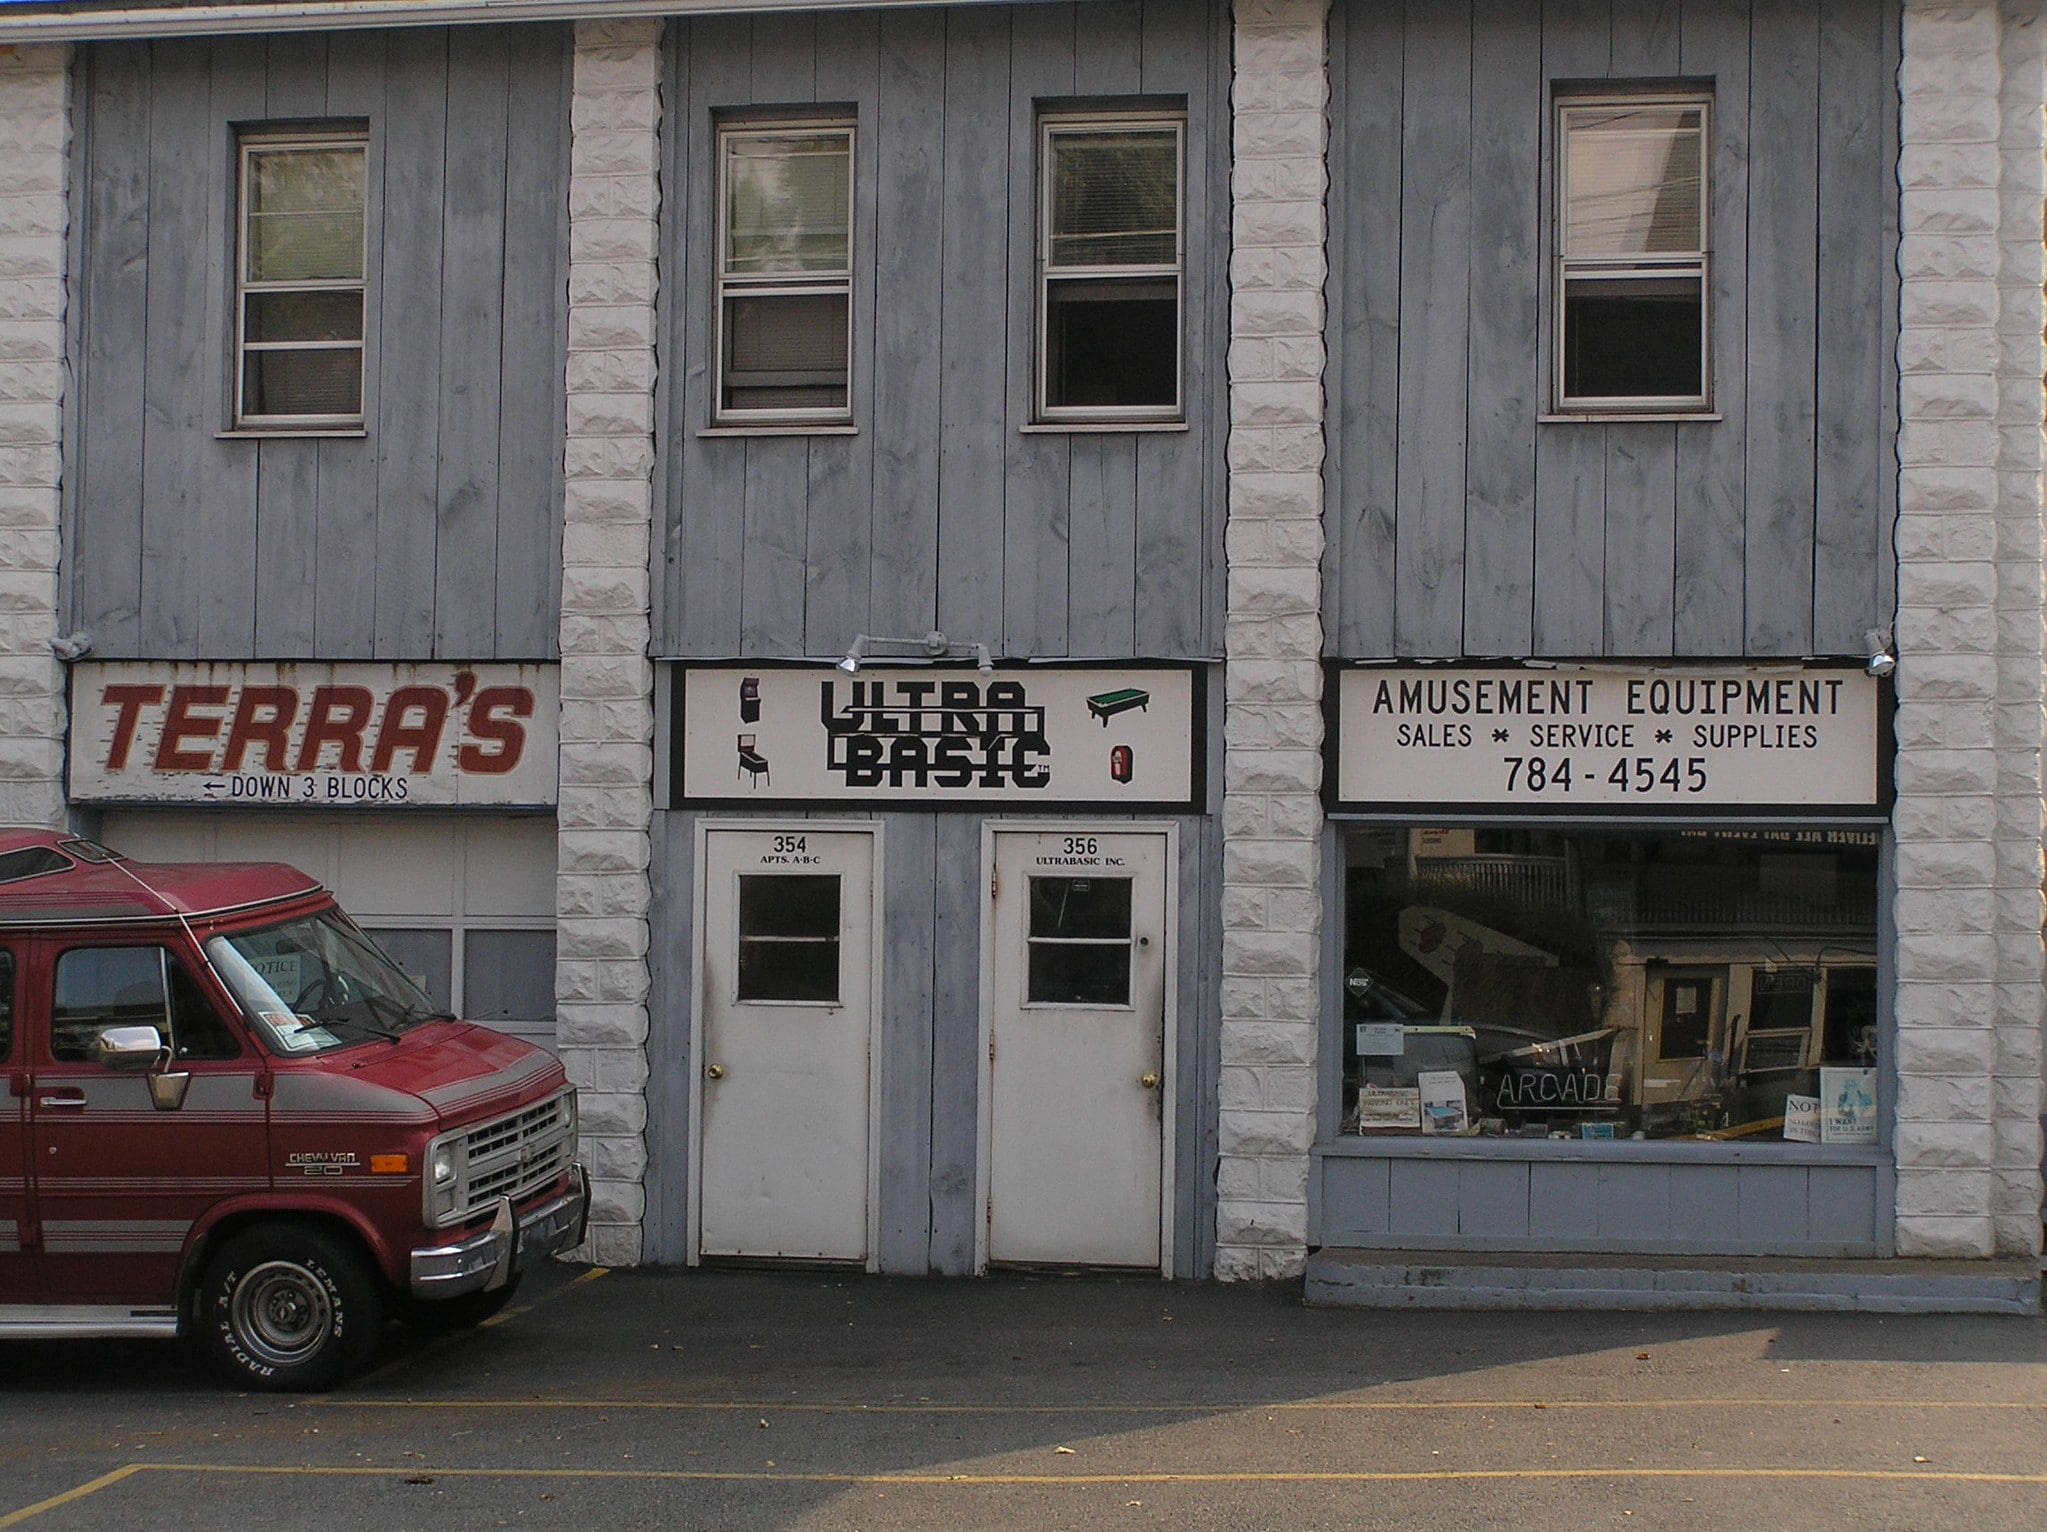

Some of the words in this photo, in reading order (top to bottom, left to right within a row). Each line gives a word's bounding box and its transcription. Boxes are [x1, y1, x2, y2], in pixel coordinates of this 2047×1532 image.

[821, 681, 1026, 732] ULTRA
[1372, 679, 1594, 715] AMUSEMENT
[1627, 680, 1844, 716] EQUIPMENT
[102, 670, 535, 775] TERRA'S
[1397, 724, 1473, 748] SALES
[1530, 724, 1635, 748] SERVICE
[1693, 725, 1819, 749] SUPPLIES
[845, 734, 1051, 788] BASIC
[231, 776, 290, 799] DOWN
[302, 777, 315, 798] 3
[328, 776, 408, 800] BLOCKS
[773, 835, 806, 853] 354
[1063, 837, 1097, 855] 356
[760, 855, 790, 864] APTS.
[1036, 856, 1100, 866] ULTRABASIC
[1105, 857, 1126, 867] INC.
[250, 960, 297, 974] OTICE
[289, 1152, 328, 1163] CHEVY
[330, 1152, 355, 1163] VAN
[303, 1165, 343, 1176] 20
[220, 1321, 275, 1376] RADIAL
